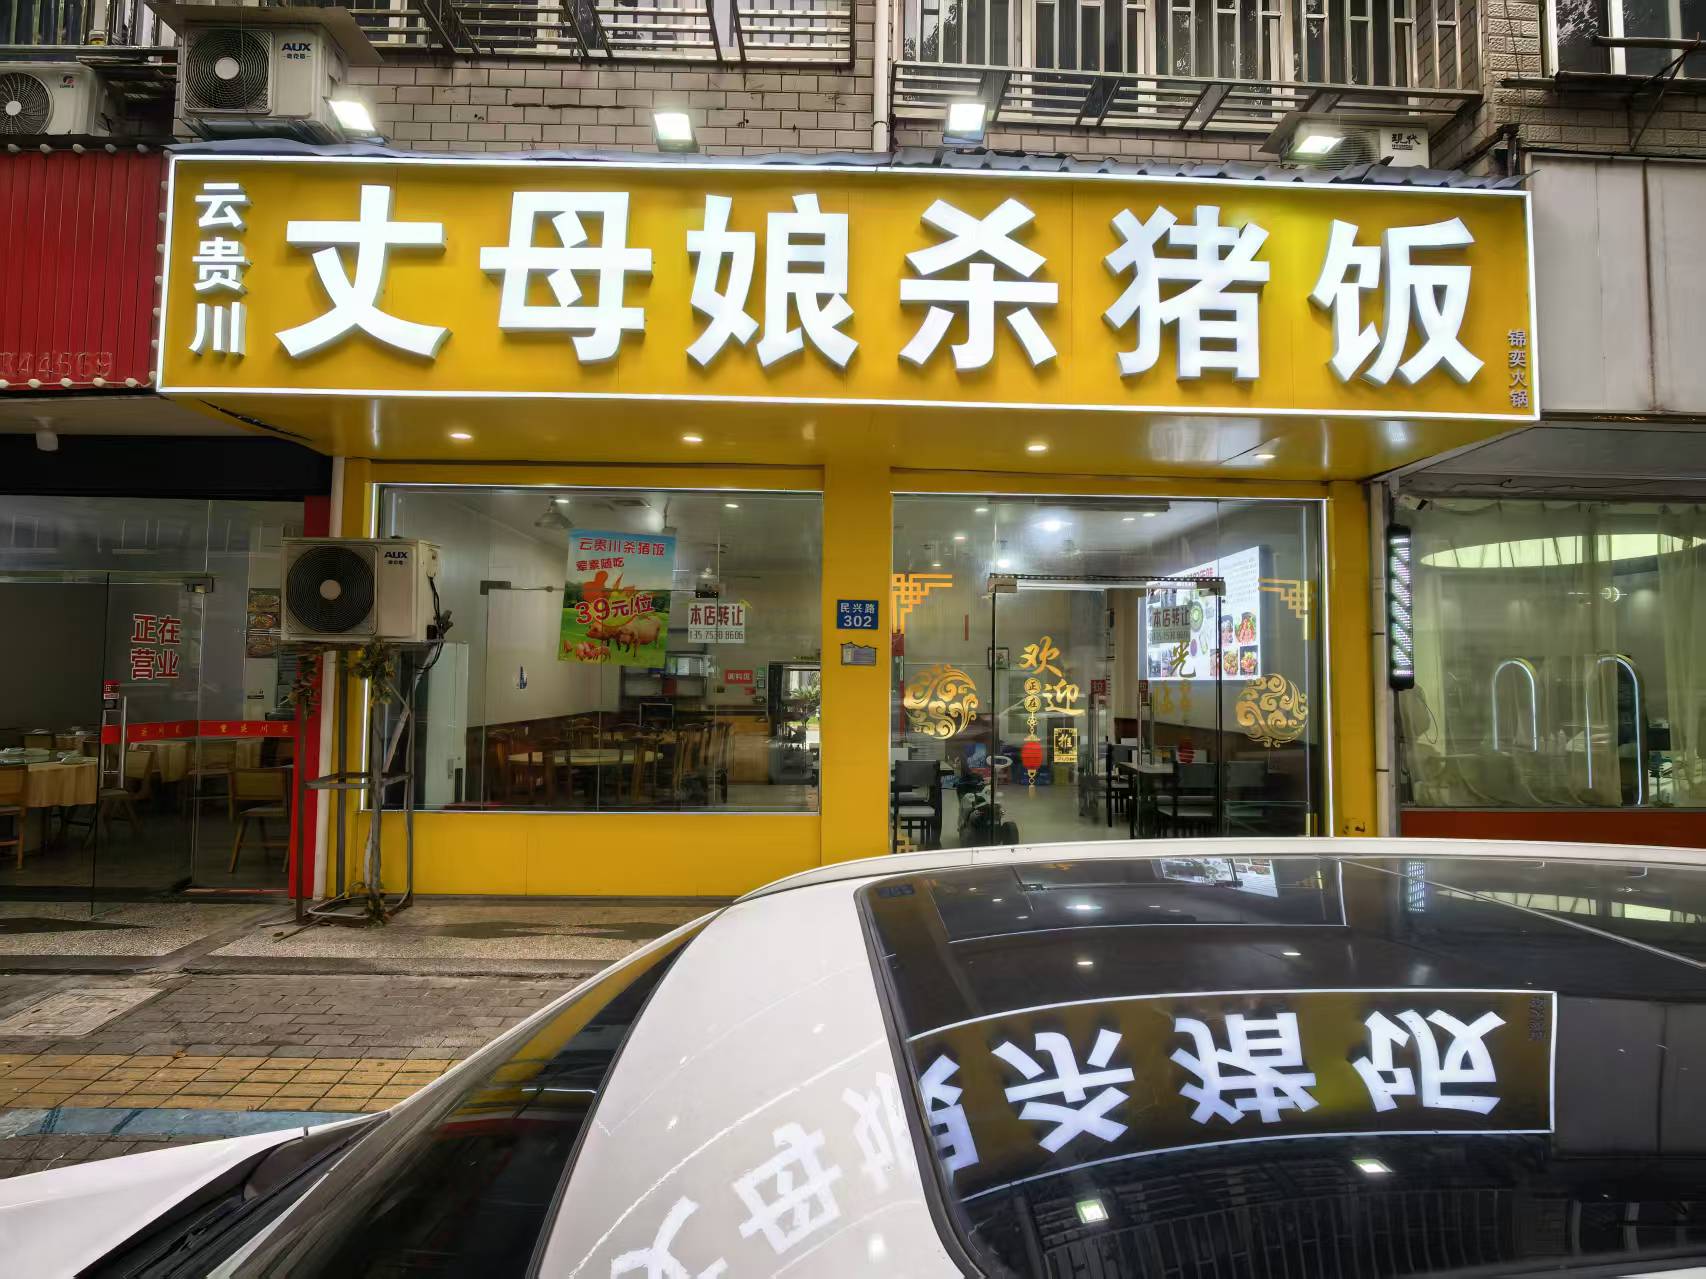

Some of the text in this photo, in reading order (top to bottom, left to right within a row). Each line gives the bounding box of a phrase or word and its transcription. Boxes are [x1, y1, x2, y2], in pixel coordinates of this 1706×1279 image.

[282, 42, 312, 51] AUX
[189, 183, 249, 357] 云贵川
[275, 184, 1485, 385] 丈母娘杀猪饭
[1507, 329, 1529, 408] 锦奕火锅
[384, 551, 409, 559] AUX
[578, 537, 665, 556] 云贵川杀猪饭
[690, 605, 744, 626] 本店转让
[840, 602, 875, 614] 民兴路
[1153, 606, 1191, 628] 本店转让
[131, 613, 182, 645] 正在
[843, 615, 872, 627] 302
[131, 647, 180, 680] 营业
